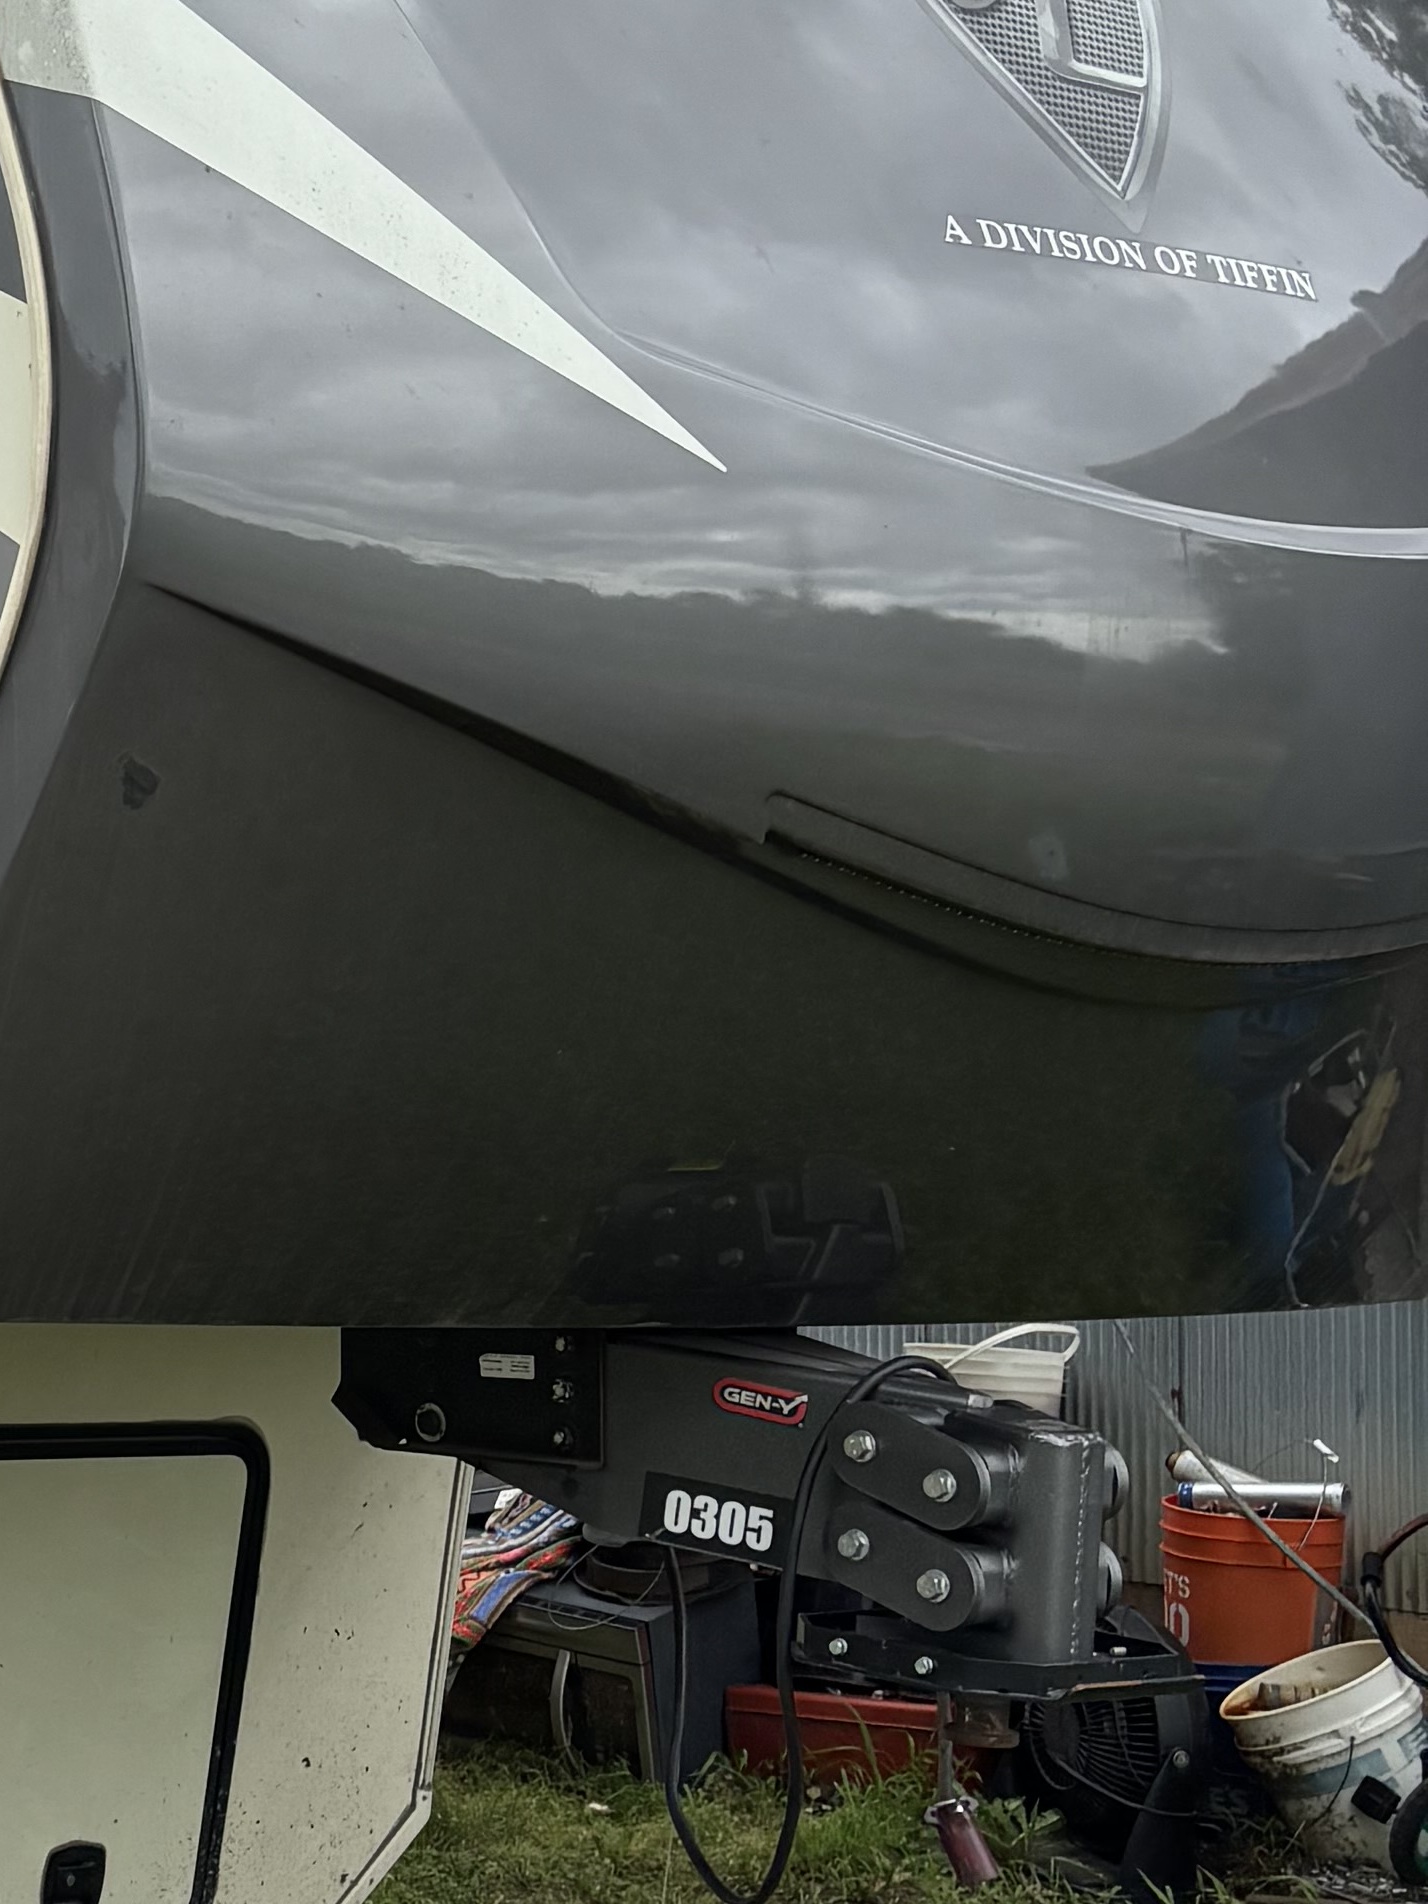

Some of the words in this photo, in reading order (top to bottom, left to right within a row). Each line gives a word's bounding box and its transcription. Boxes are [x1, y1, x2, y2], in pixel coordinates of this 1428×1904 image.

[945, 214, 972, 246] A
[976, 217, 1147, 271] DIVISION
[1154, 245, 1198, 279] OF
[1206, 253, 1317, 300] TIFFIN
[723, 1387, 808, 1415] GEN-Y
[663, 1489, 774, 1552] 0305
[1164, 1568, 1191, 1599] T'S
